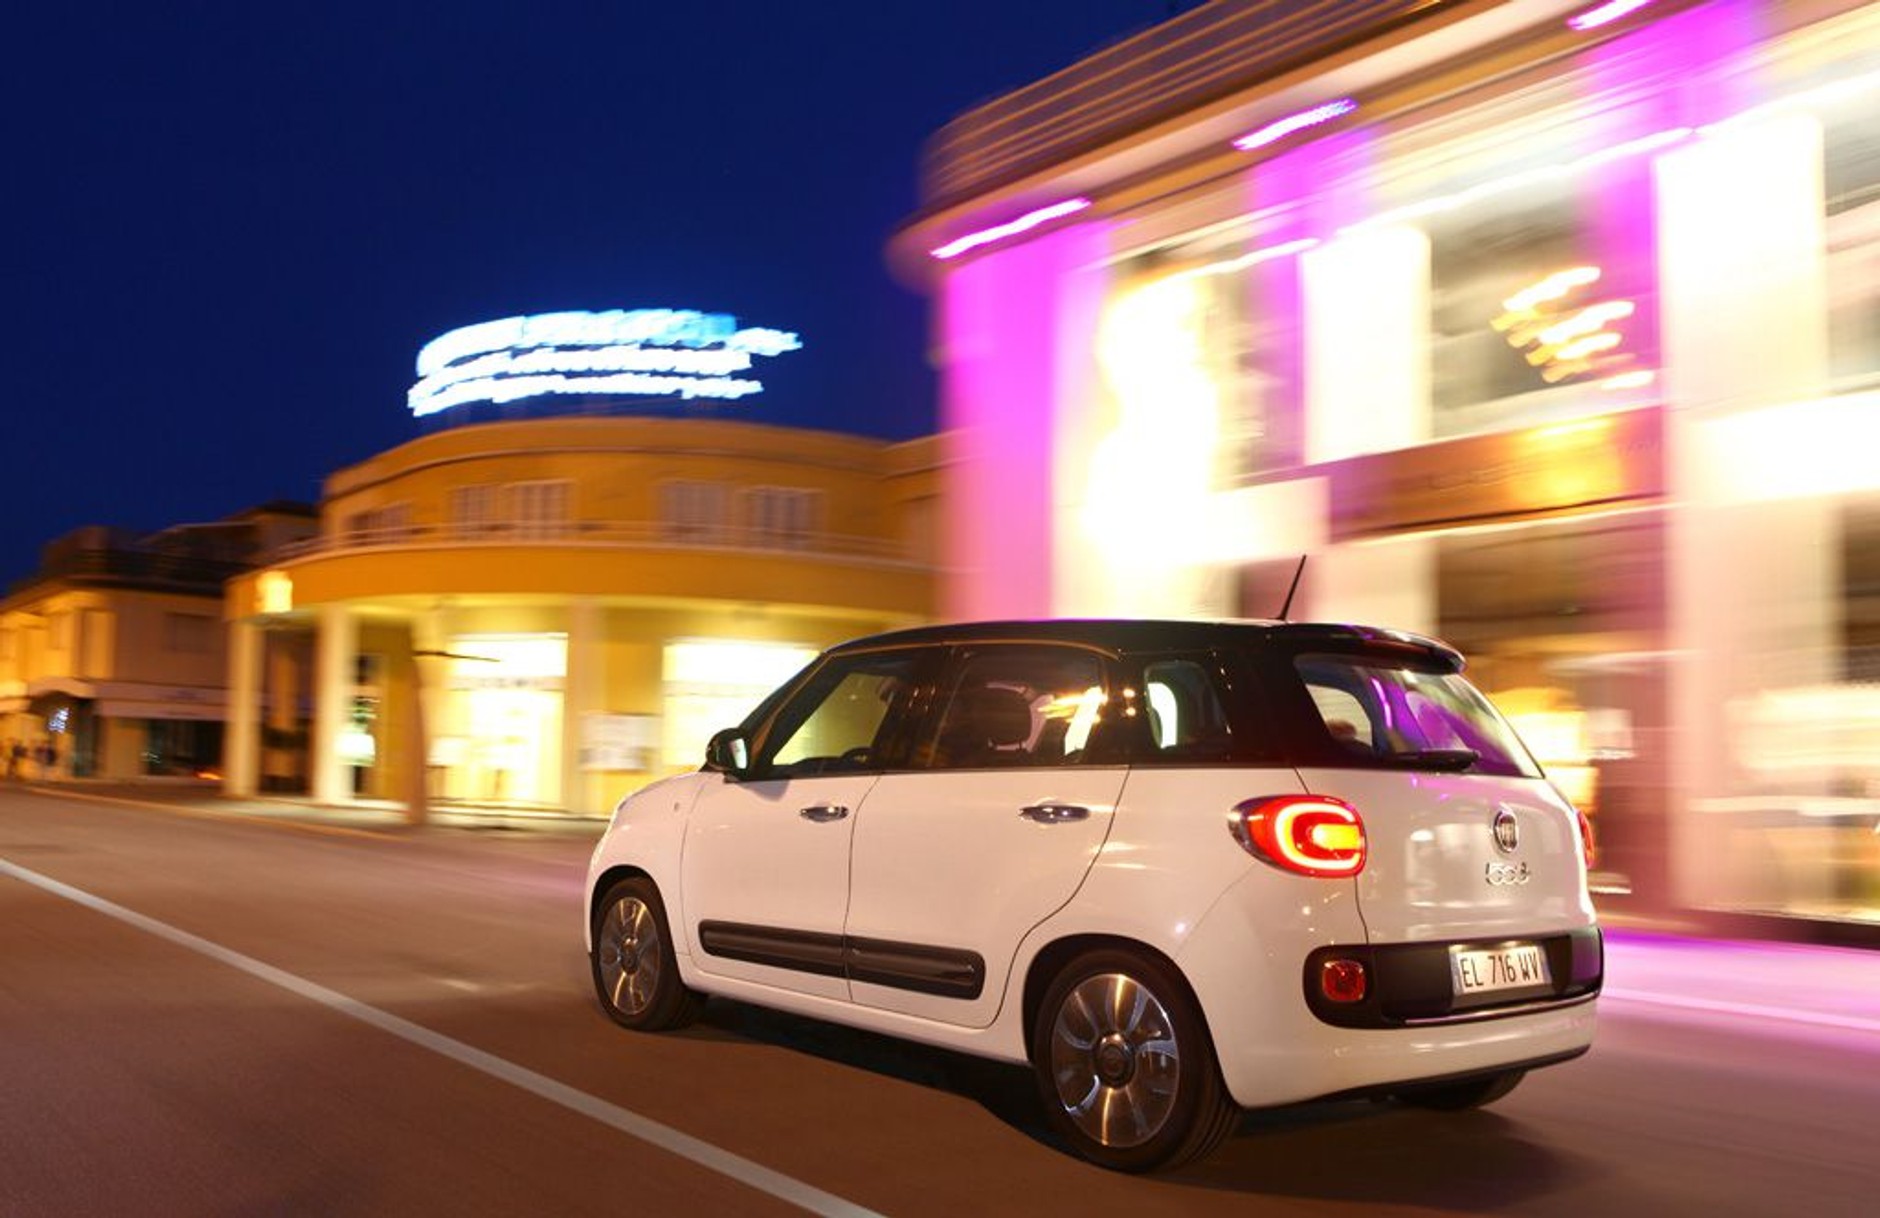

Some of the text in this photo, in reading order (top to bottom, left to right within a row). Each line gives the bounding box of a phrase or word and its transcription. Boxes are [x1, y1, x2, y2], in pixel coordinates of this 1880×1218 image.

[1460, 952, 1539, 988] EL 716 WV
